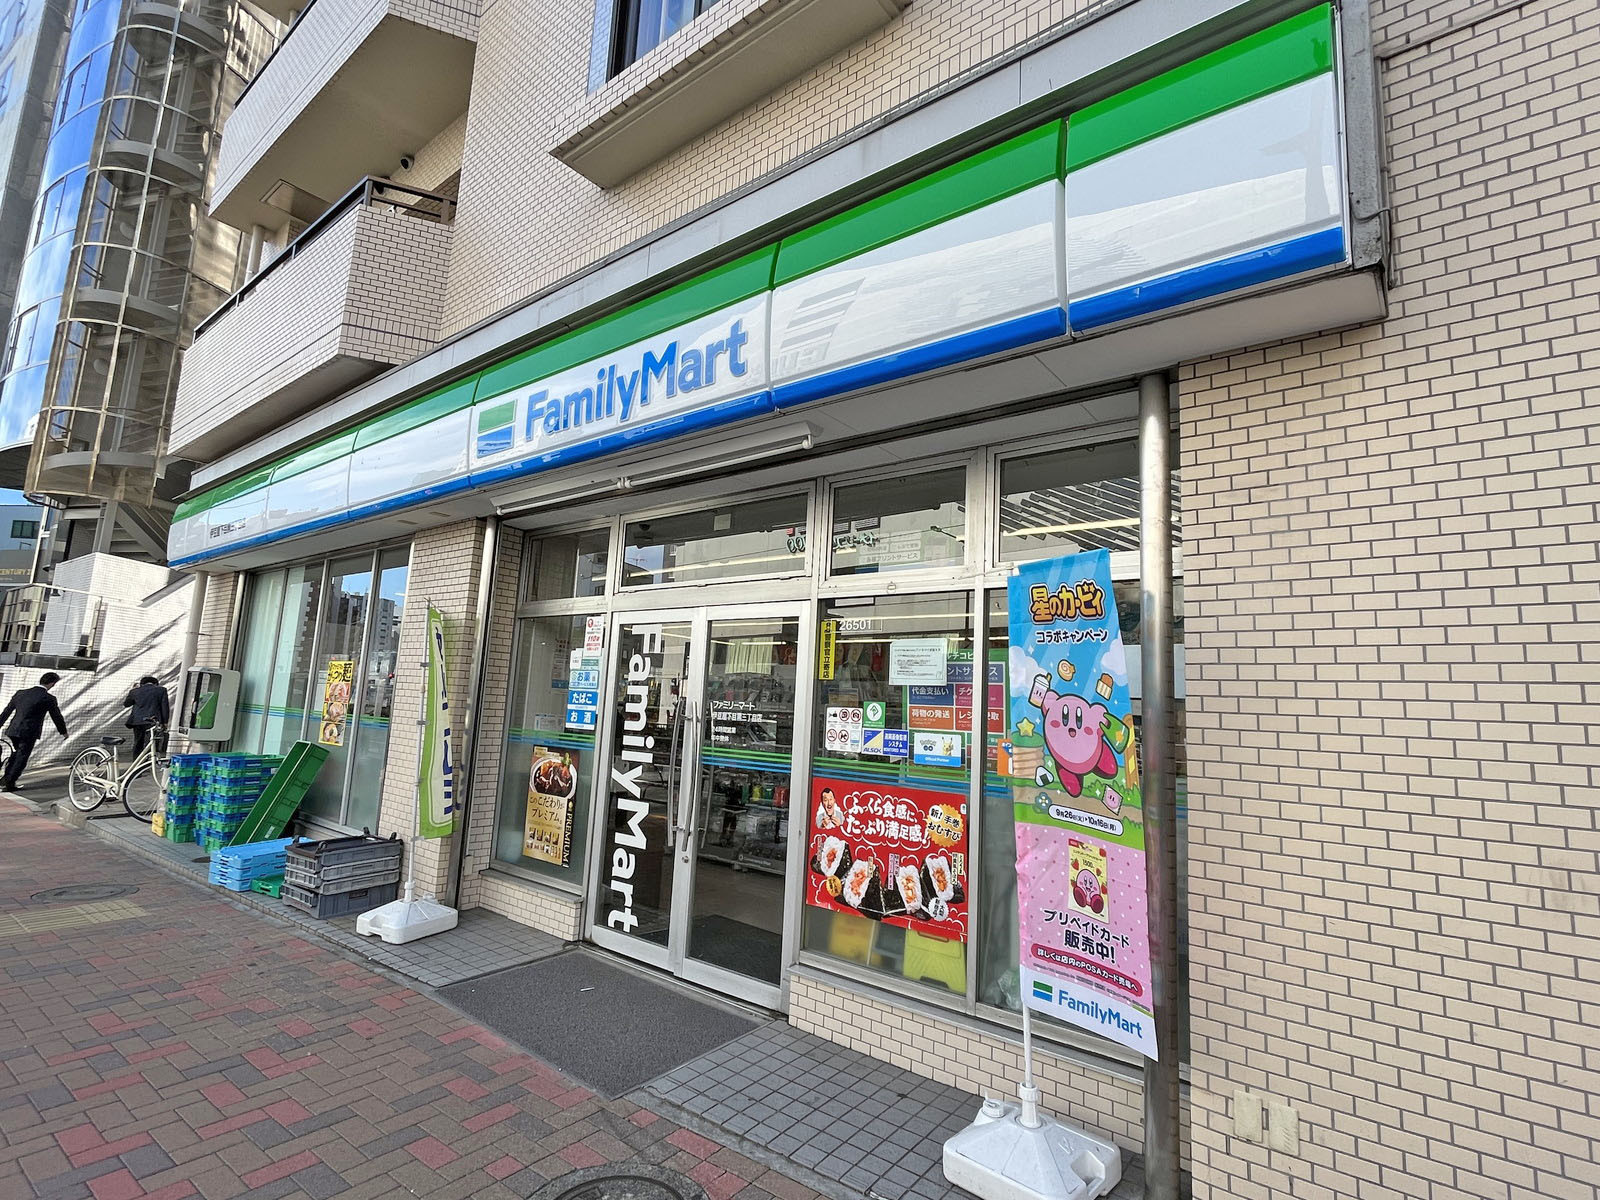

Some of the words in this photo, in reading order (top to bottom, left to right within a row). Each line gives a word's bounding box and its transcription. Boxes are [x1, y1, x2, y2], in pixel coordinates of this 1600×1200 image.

[525, 318, 749, 442] FamilyMart
[839, 620, 871, 631] 26501
[1036, 629, 1107, 643] コラボキャンペーン
[572, 692, 592, 704] たばこ
[911, 687, 949, 696] 代金支払い
[713, 700, 756, 711] ファミリーマート
[571, 711, 592, 723] お酒
[911, 709, 950, 719] 荷物の発送
[608, 624, 662, 933] FamilyMart
[562, 813, 573, 862] PREMIUM
[928, 822, 961, 840] おむすび
[1044, 910, 1130, 948] プリペイドカード
[1065, 930, 1115, 963] 販売中!
[1059, 990, 1142, 1038] FamilyMart
